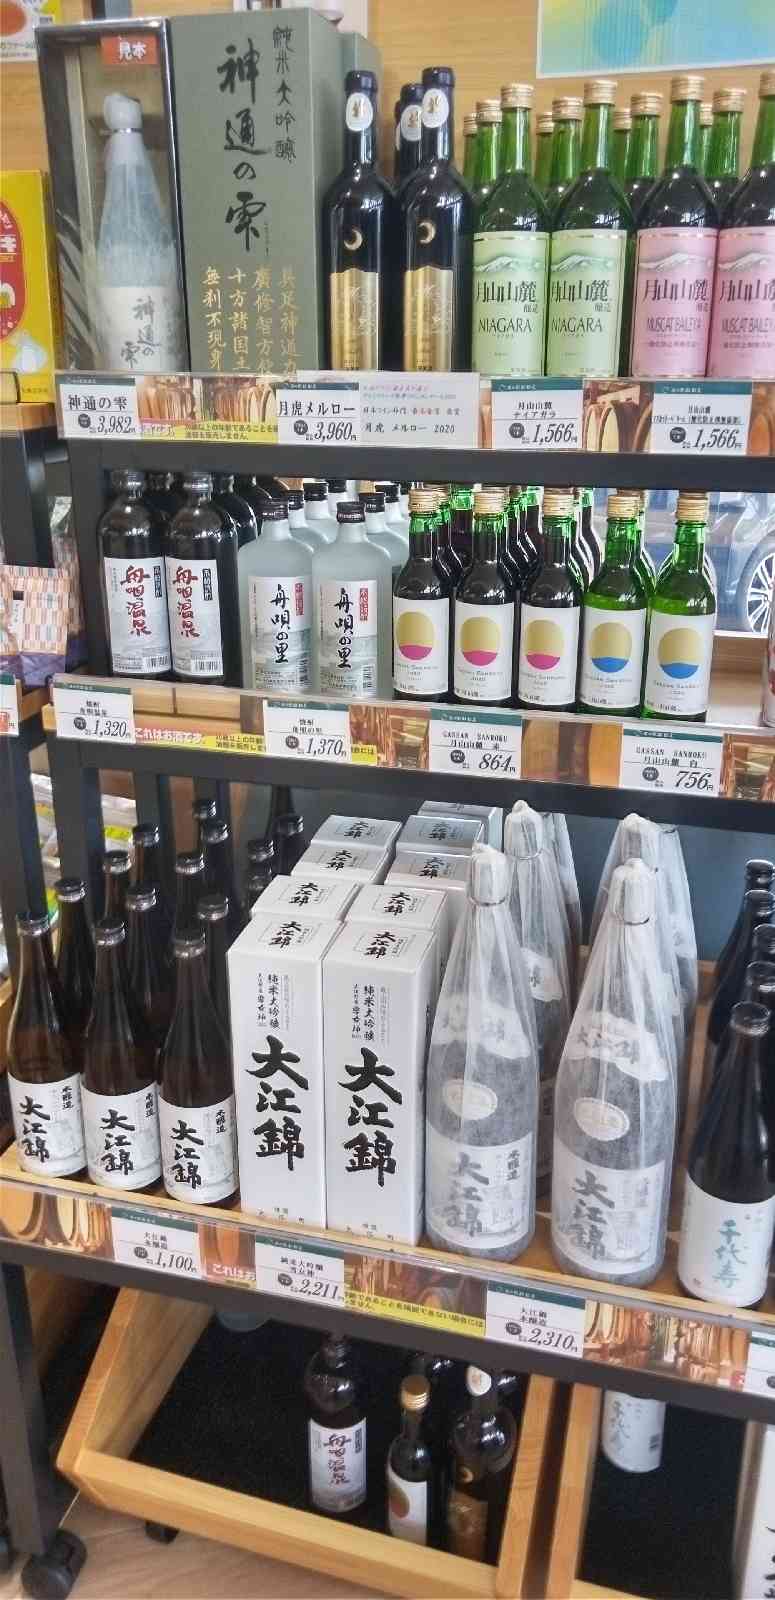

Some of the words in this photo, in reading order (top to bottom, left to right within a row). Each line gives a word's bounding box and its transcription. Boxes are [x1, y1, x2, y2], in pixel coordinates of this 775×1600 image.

[118, 40, 146, 60] 見本
[272, 26, 297, 164] 純米大吟醸
[476, 280, 537, 302] 月山山麓
[478, 317, 532, 333] NIAGARA
[551, 317, 603, 333] NIAGARA
[279, 400, 356, 417] 月虎メルロー
[513, 411, 556, 419] ナイアガラ
[392, 423, 428, 433] メルロー
[433, 423, 456, 433] 2020
[270, 583, 290, 664] 舟唄の里
[334, 587, 354, 669] 舟唄の里
[477, 733, 508, 742] SANROKU
[636, 746, 665, 756] GASSAN
[673, 750, 707, 760] SANROKU
[289, 882, 320, 907] 大江錦
[384, 891, 411, 916] 大江錦
[269, 920, 302, 949] 大江錦
[364, 931, 396, 959] 大江錦
[268, 974, 280, 1029] 純米大吟醸
[364, 985, 375, 1040] 純米大吟醸
[245, 1035, 309, 1171] 大江錦
[337, 1047, 403, 1187] 大江錦
[19, 1095, 51, 1163] 大江錦
[100, 1109, 136, 1176] 大江錦
[170, 1119, 204, 1190] 大江錦
[568, 1169, 616, 1260] 大江錦
